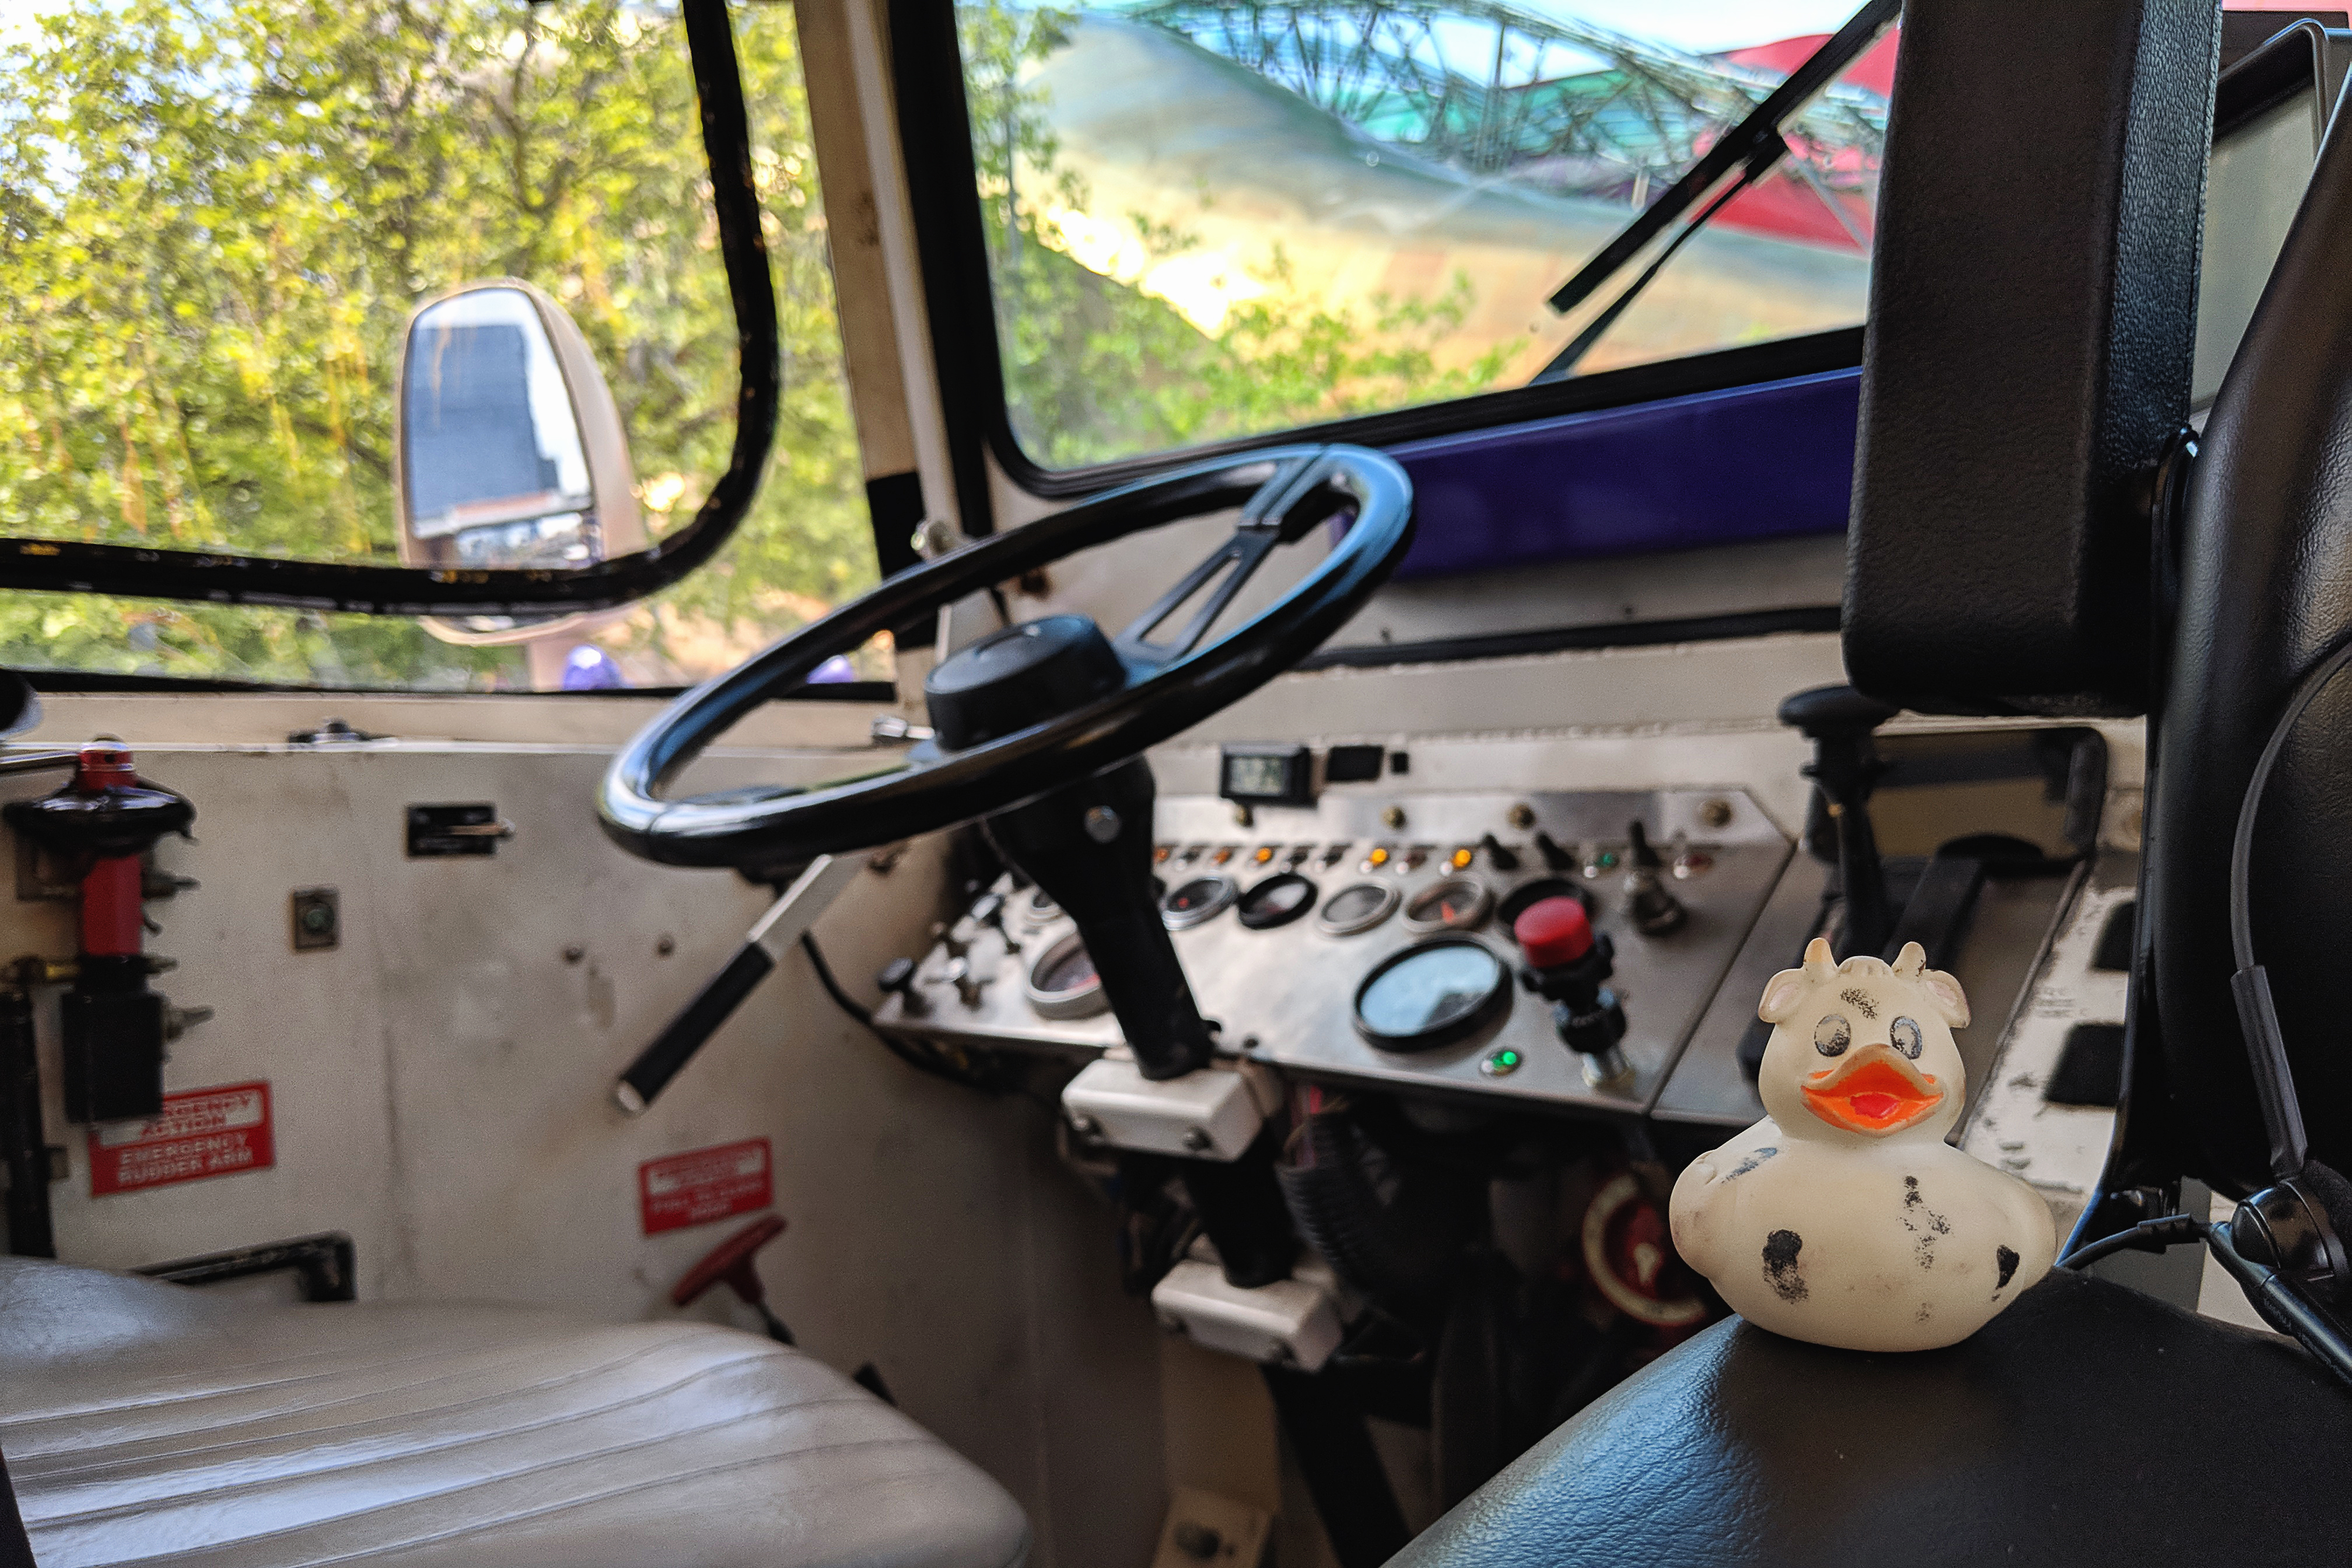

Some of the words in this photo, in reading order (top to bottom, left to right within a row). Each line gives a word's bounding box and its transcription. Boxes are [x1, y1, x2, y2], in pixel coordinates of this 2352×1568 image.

[120, 1133, 248, 1165] EMERGENCY
[117, 1158, 202, 1184] RUDDER
[209, 1149, 254, 1170] ARM
